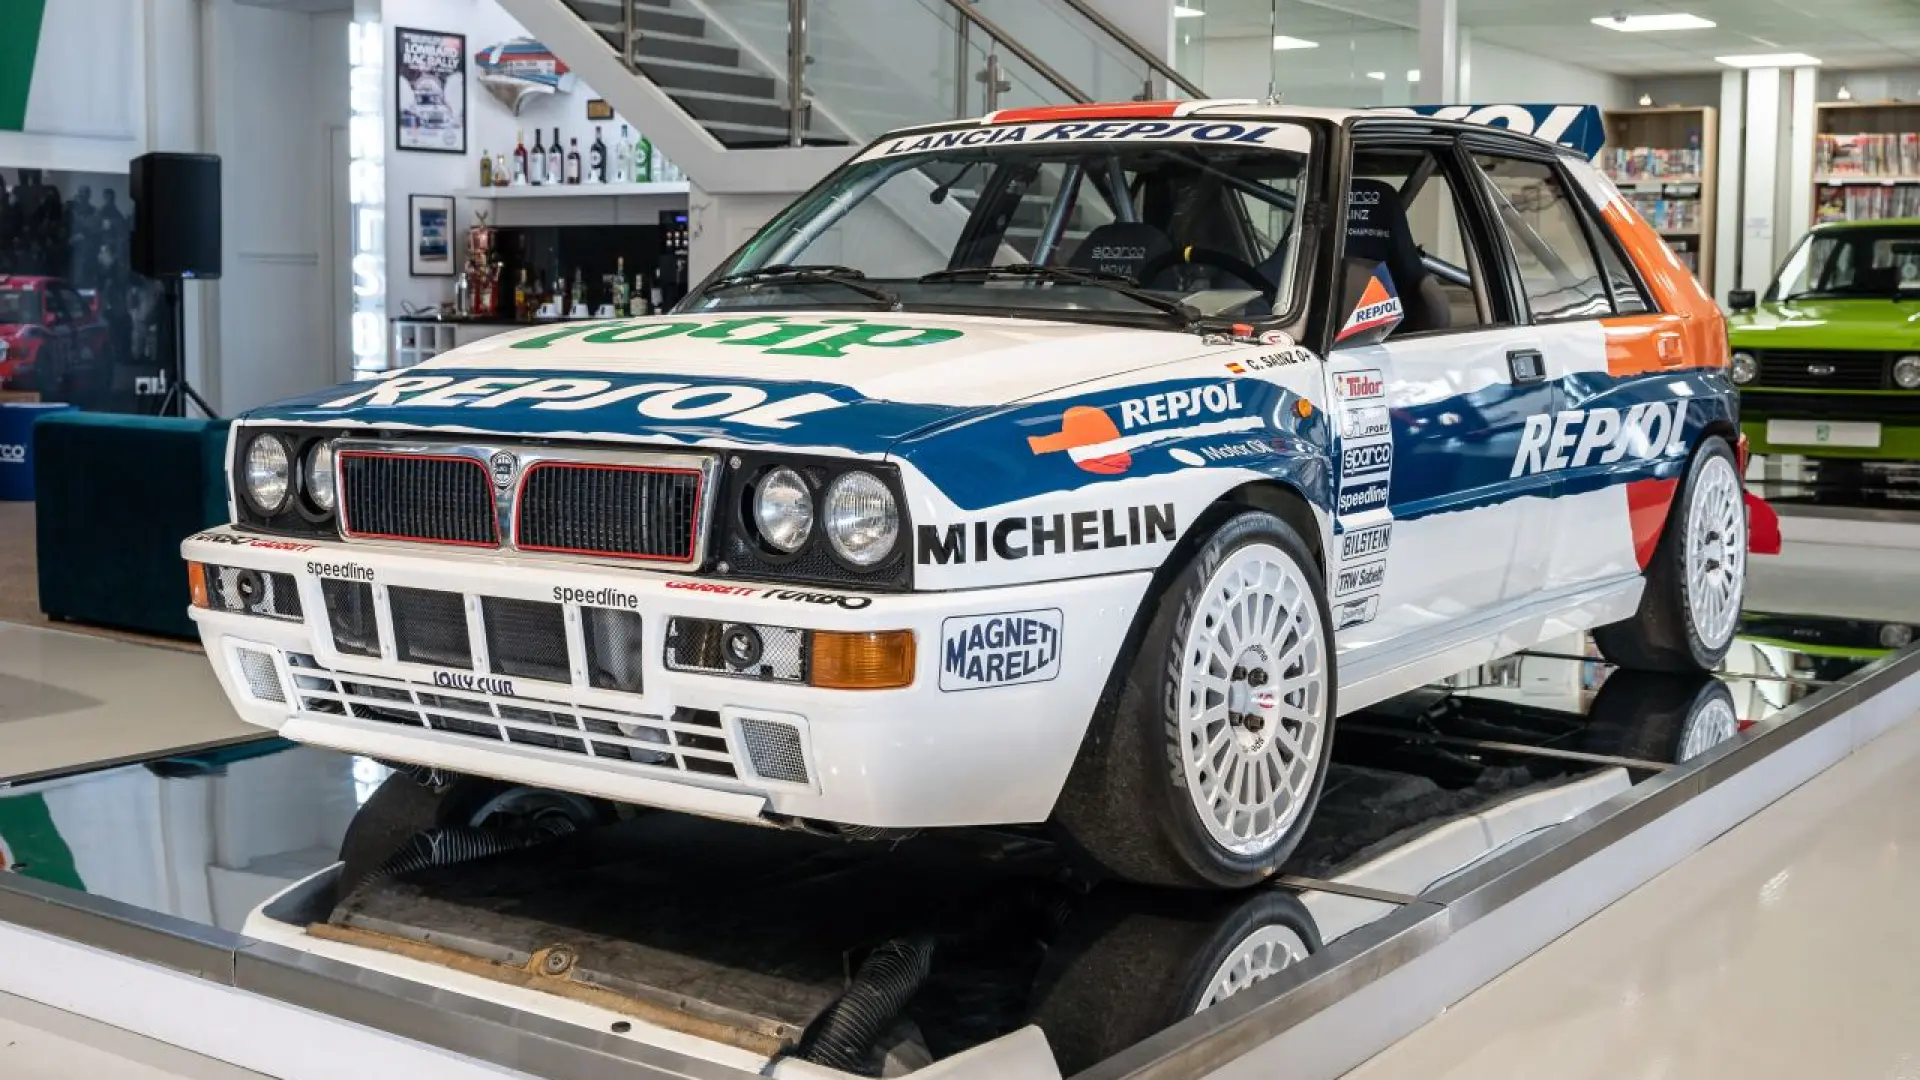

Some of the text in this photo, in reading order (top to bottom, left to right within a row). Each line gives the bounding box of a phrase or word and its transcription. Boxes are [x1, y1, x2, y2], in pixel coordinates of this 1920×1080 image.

[885, 122, 1279, 155] LANCIA REPSOL
[1356, 299, 1397, 323] REPSOL
[317, 375, 850, 430] REPSOL
[1121, 382, 1243, 430] REPSOL
[1510, 399, 1690, 478] REPSOL
[1345, 444, 1390, 470] sparco
[1340, 486, 1388, 511] speedline
[918, 502, 1177, 565] MICHELIN
[1343, 527, 1390, 557] BILSTEIN
[307, 560, 375, 581] speedline
[1340, 571, 1359, 590] TRW
[553, 584, 639, 608] speedline
[947, 617, 1056, 665] MAGNETI
[946, 640, 1056, 681] MARELLI
